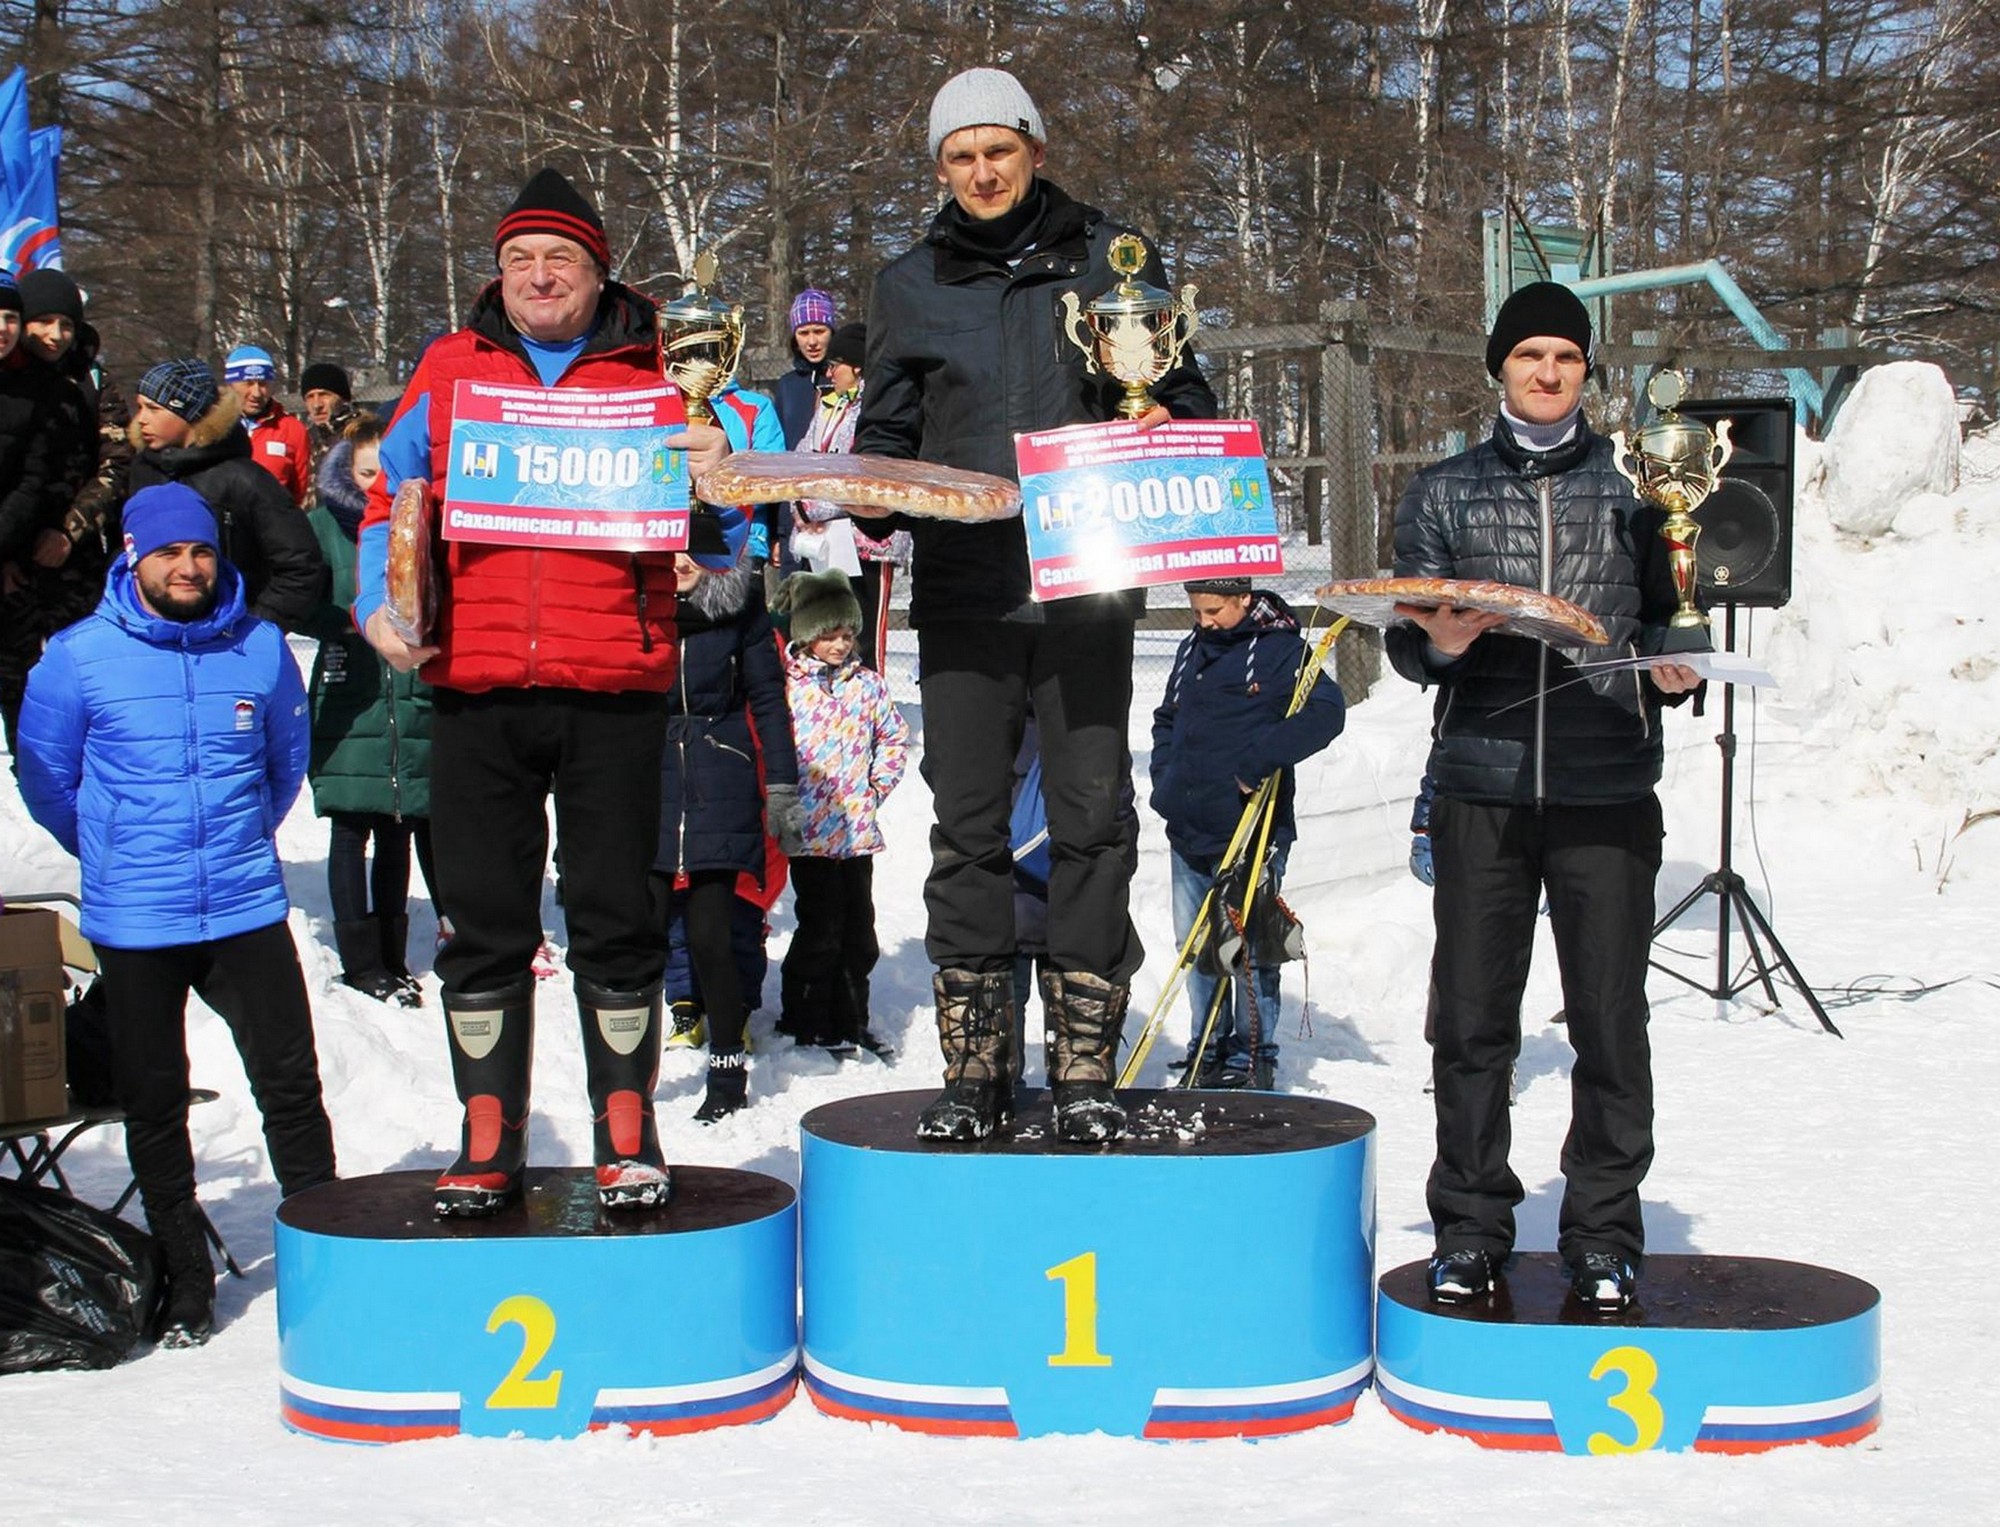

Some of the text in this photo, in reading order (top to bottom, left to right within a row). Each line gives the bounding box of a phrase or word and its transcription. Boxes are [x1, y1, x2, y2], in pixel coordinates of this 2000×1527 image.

[513, 444, 641, 488] 15000
[449, 508, 686, 538] Сахалинская лыжня 2017
[1085, 474, 1222, 529] 20000
[1038, 543, 1277, 588] Сахакая лыжня 2017
[1045, 1252, 1112, 1368] 1
[484, 1294, 563, 1409] 2
[1587, 1345, 1665, 1456] 3
